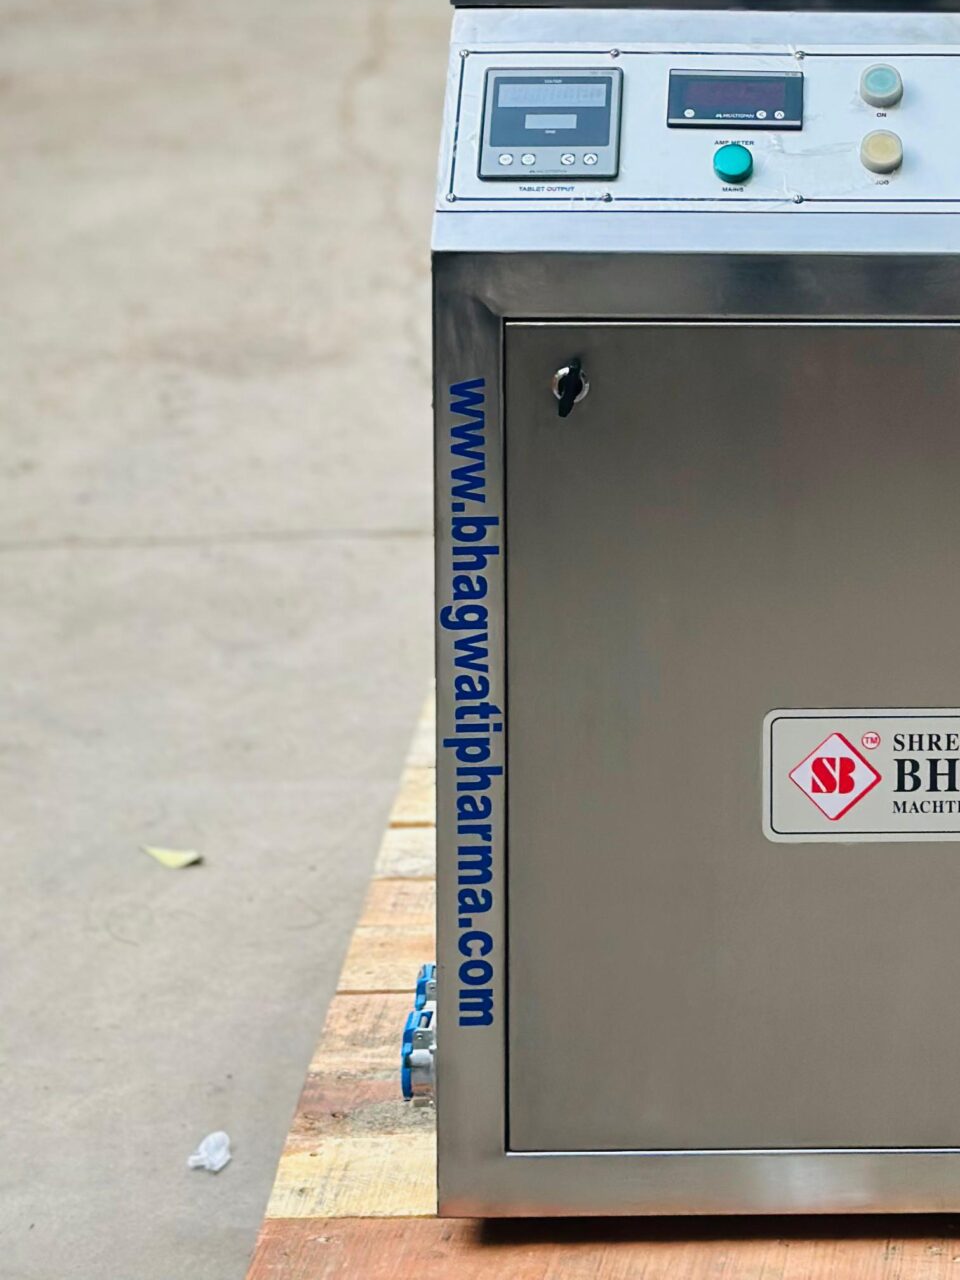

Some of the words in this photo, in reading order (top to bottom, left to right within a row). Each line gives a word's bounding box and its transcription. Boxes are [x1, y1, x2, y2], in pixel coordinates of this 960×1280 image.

[440, 378, 502, 1026] www.bhagwatipharma.com
[863, 736, 878, 744] TM
[811, 757, 856, 794] SB
